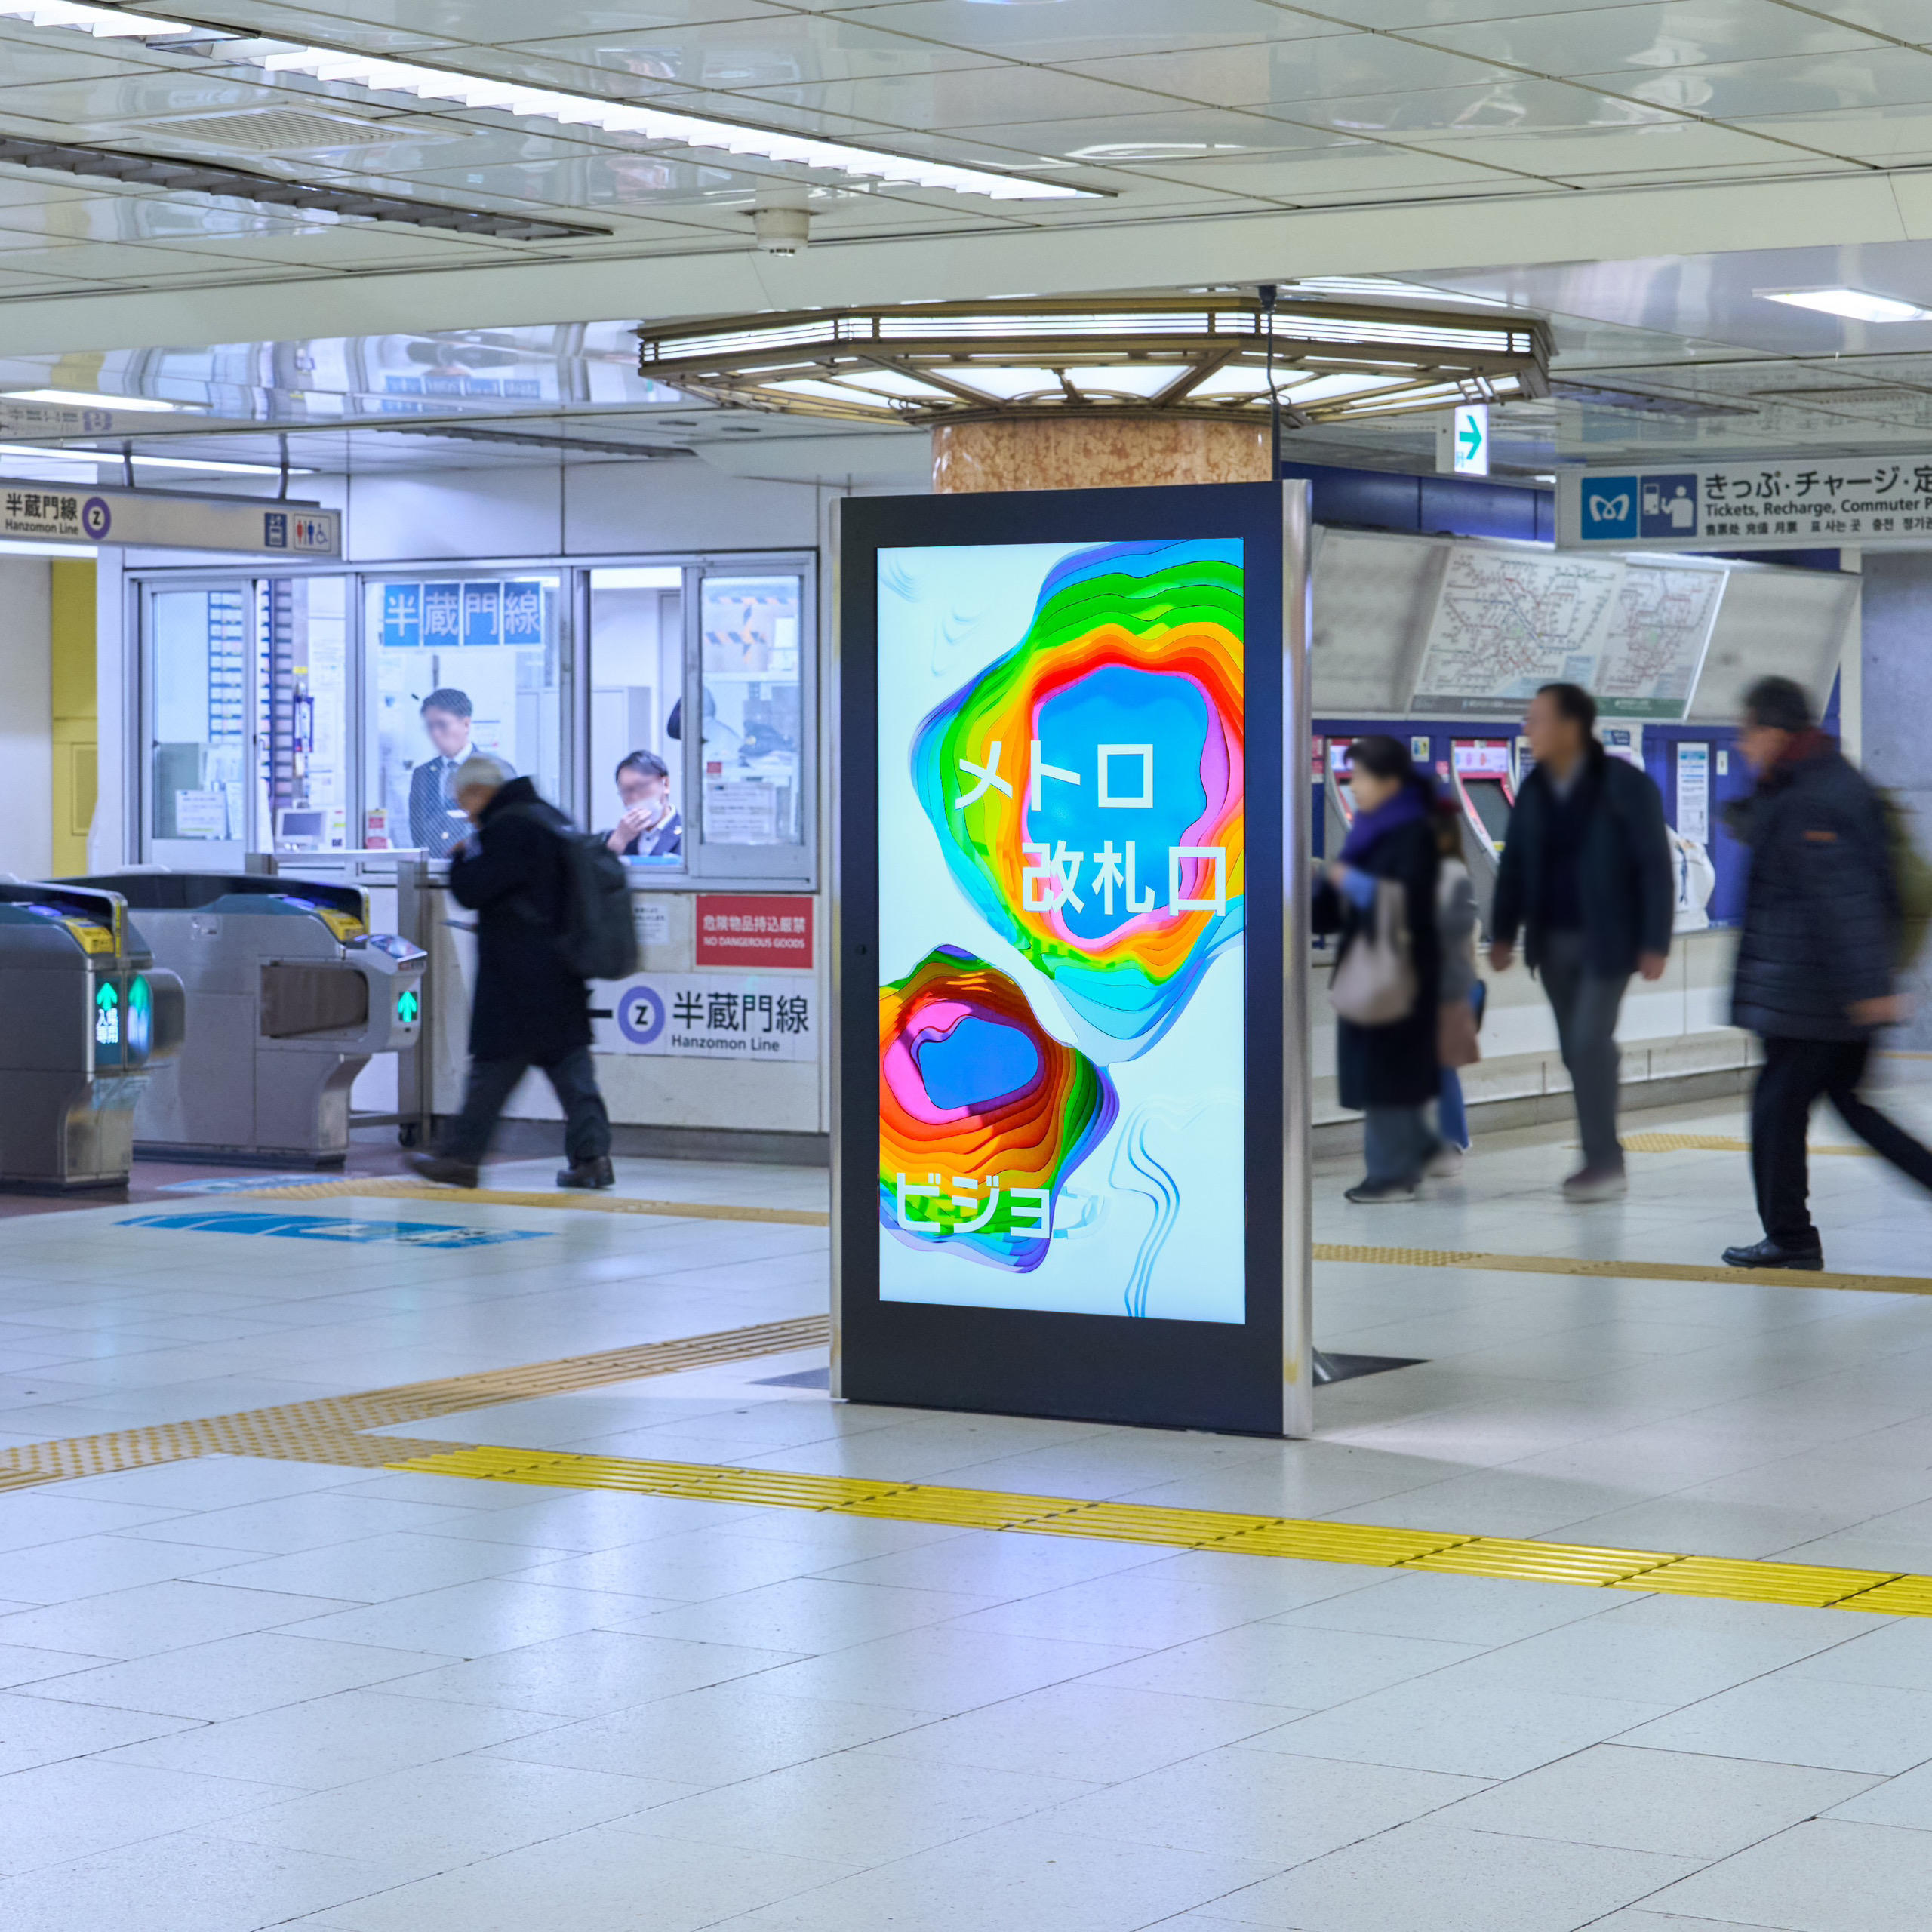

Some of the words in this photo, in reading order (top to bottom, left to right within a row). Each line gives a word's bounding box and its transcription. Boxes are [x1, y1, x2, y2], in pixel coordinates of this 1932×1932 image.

[6, 493, 78, 521] 半蔵門線
[92, 510, 101, 525] Z
[1706, 503, 1759, 518] Tickets,
[1764, 501, 1836, 516] Recharge,
[1841, 500, 1920, 512] Commuter
[5, 518, 57, 532] Hanzomon
[60, 523, 78, 534] Line
[385, 590, 541, 638] 半蔵門線
[955, 740, 1153, 811] メトロ
[1023, 840, 1226, 917] 改札口
[703, 937, 717, 947] NO
[719, 937, 772, 948] DANGEROUS
[774, 938, 805, 949] GOODS
[635, 1005, 648, 1026] Z
[673, 991, 809, 1035] 半蔵門線
[672, 1035, 746, 1050] Hanzomon
[751, 1038, 780, 1052] Line
